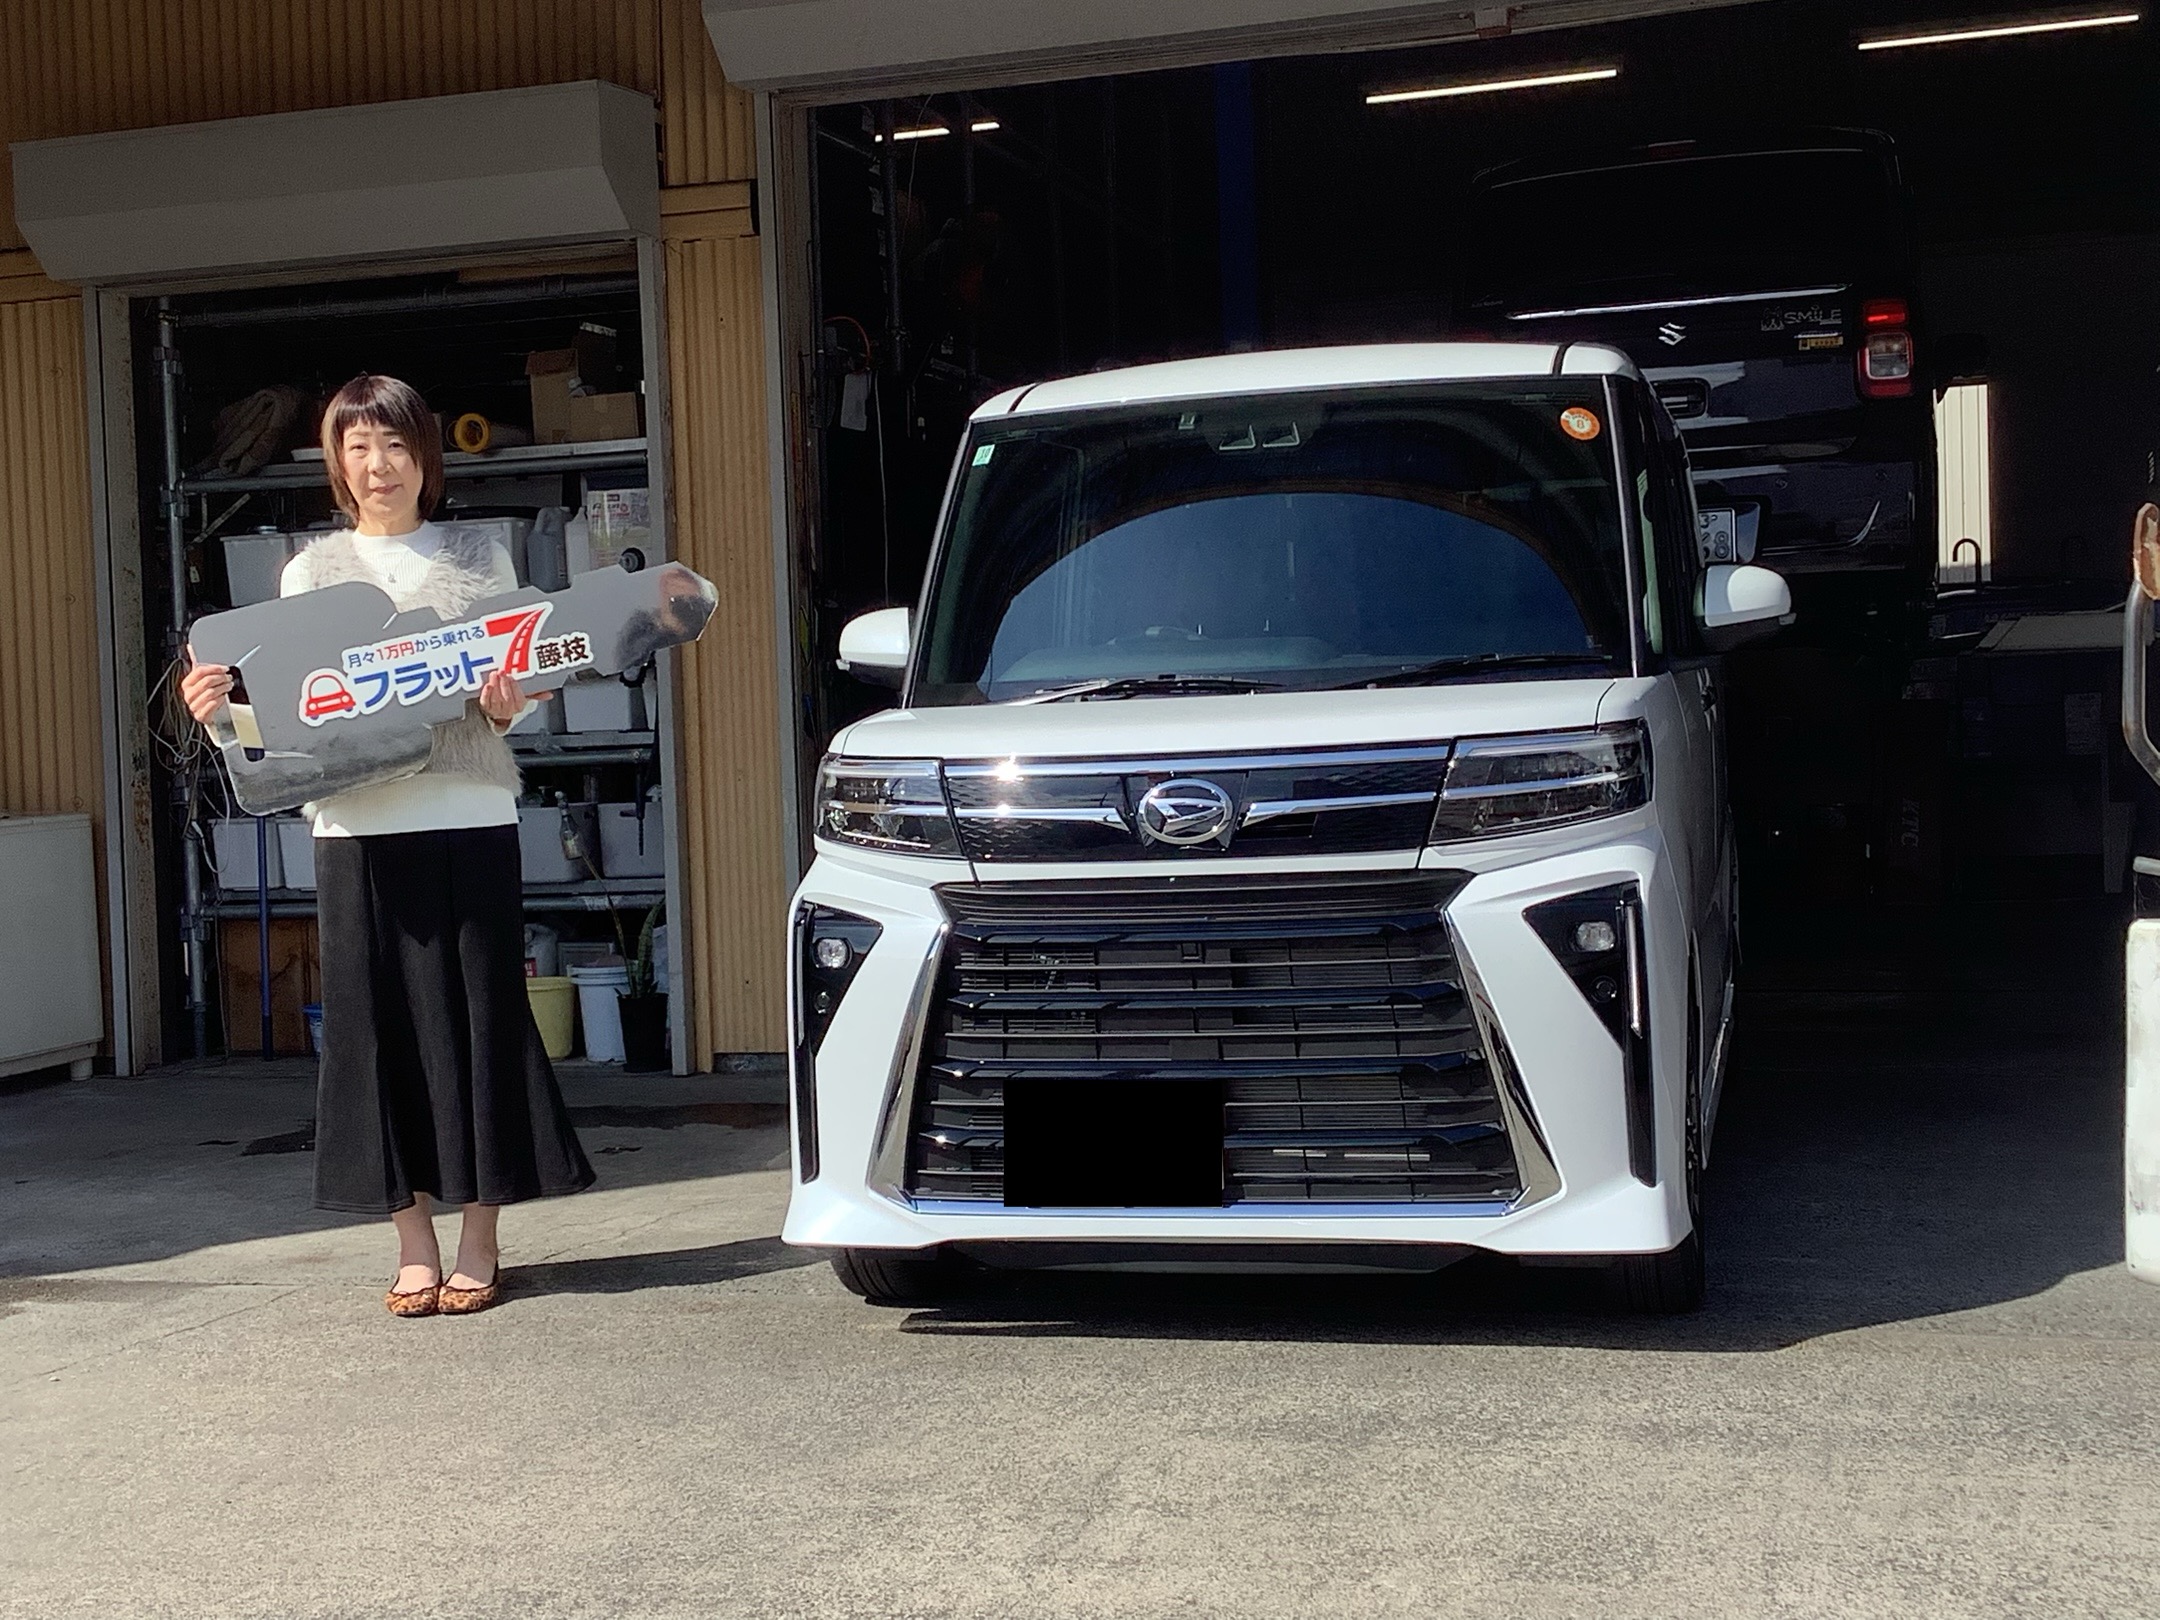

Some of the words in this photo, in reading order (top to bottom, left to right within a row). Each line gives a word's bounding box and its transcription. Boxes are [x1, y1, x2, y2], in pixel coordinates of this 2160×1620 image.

[347, 625, 486, 669] 月々1万円から乗れる
[534, 636, 589, 670] 藤枝
